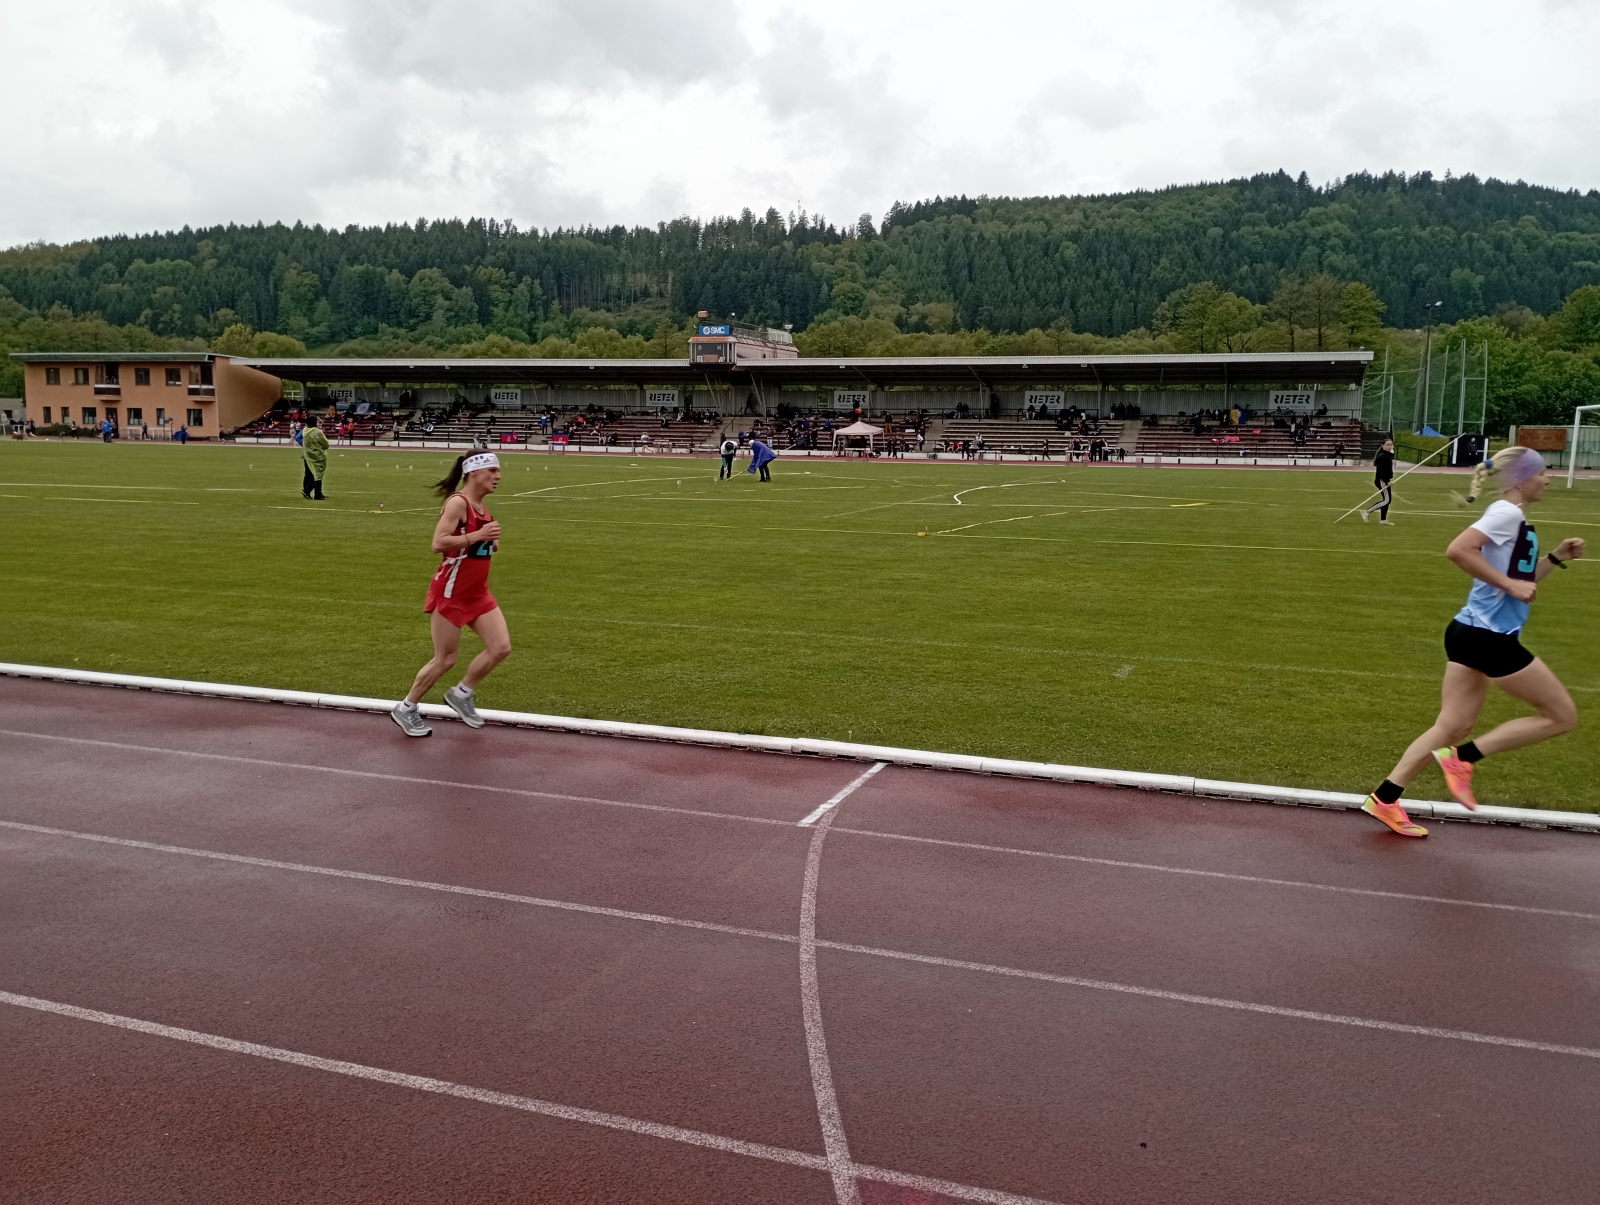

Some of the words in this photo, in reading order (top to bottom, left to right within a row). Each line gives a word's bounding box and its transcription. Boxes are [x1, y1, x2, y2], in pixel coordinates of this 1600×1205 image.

[330, 390, 353, 398] RIETER
[494, 392, 518, 400] RIETER
[649, 393, 675, 401] RIETER
[838, 395, 866, 403] RIETER
[1029, 395, 1060, 404] RIETER
[1274, 395, 1310, 404] RIETER
[1518, 530, 1540, 573] 3
